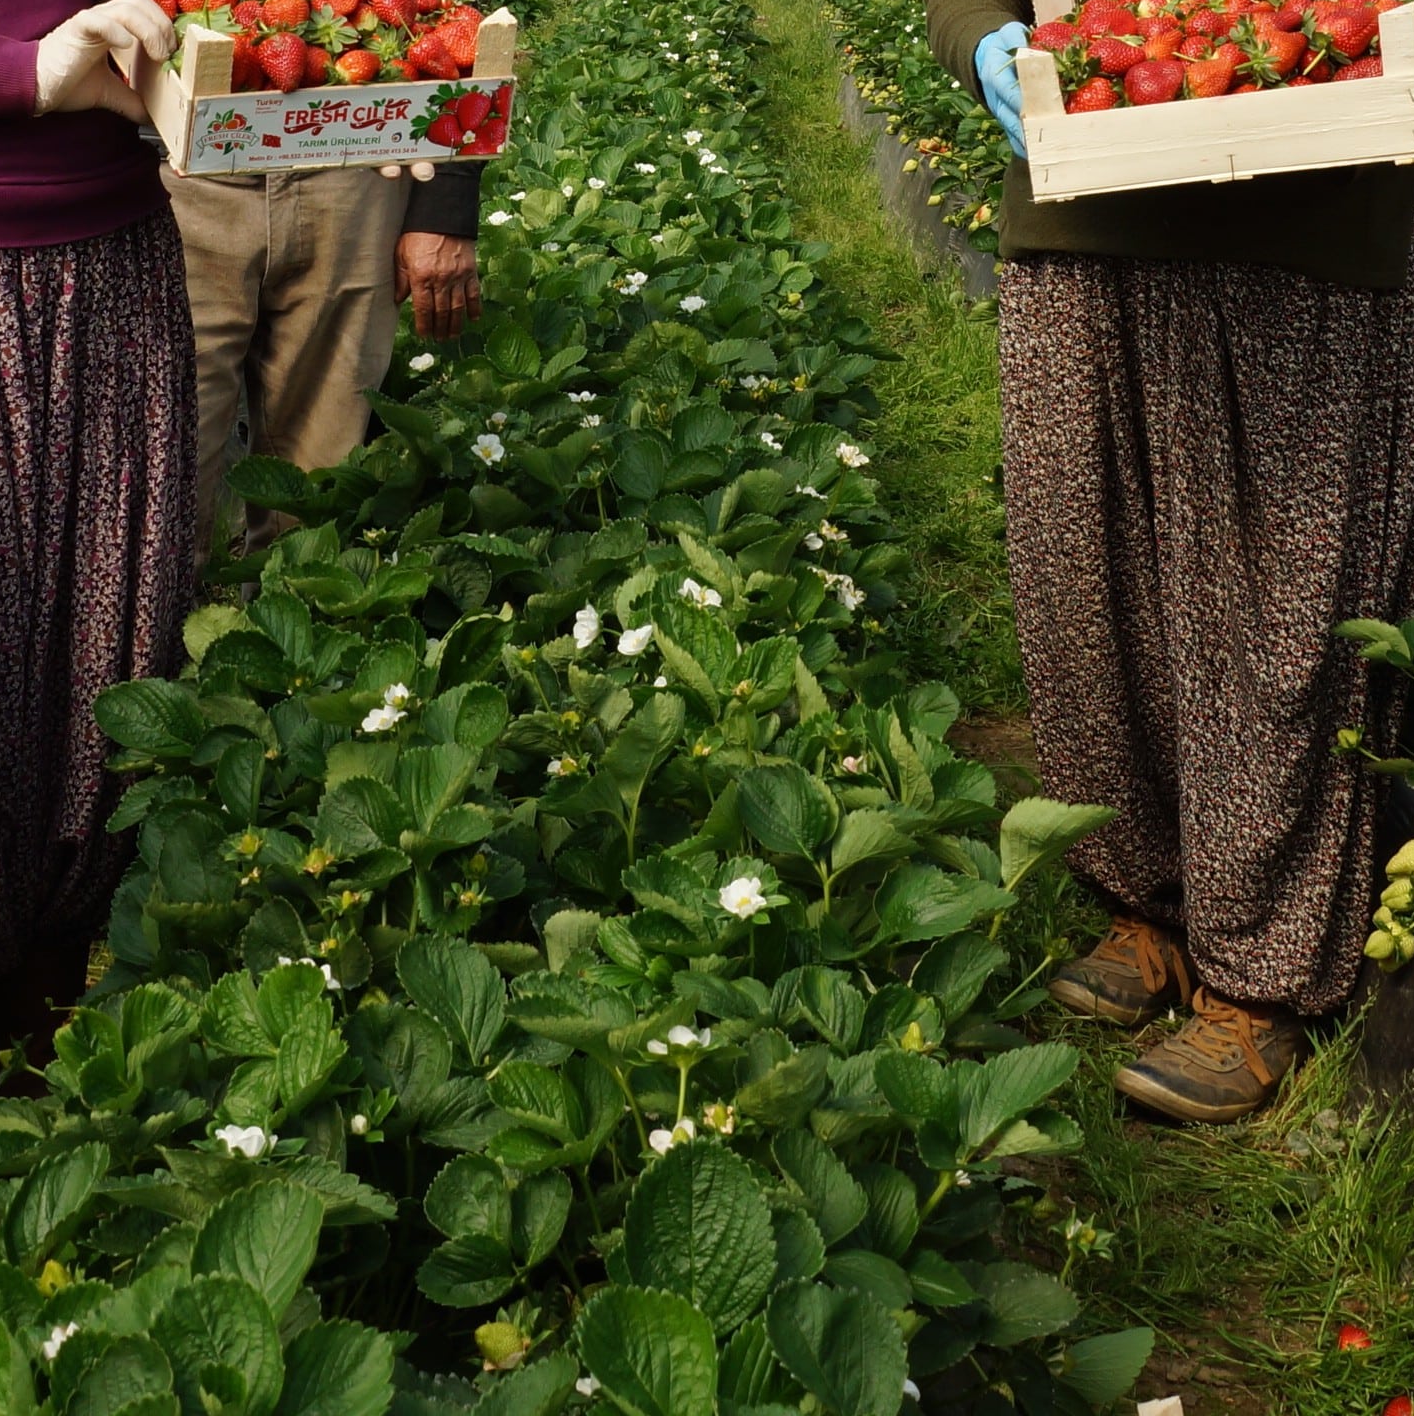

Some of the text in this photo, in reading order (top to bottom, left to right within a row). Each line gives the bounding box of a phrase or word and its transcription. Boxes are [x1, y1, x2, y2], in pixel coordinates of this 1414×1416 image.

[256, 99, 284, 107] Turkey
[284, 103, 349, 129] FRESH
[298, 135, 381, 148] TARIM ÜRÜNLERİ
